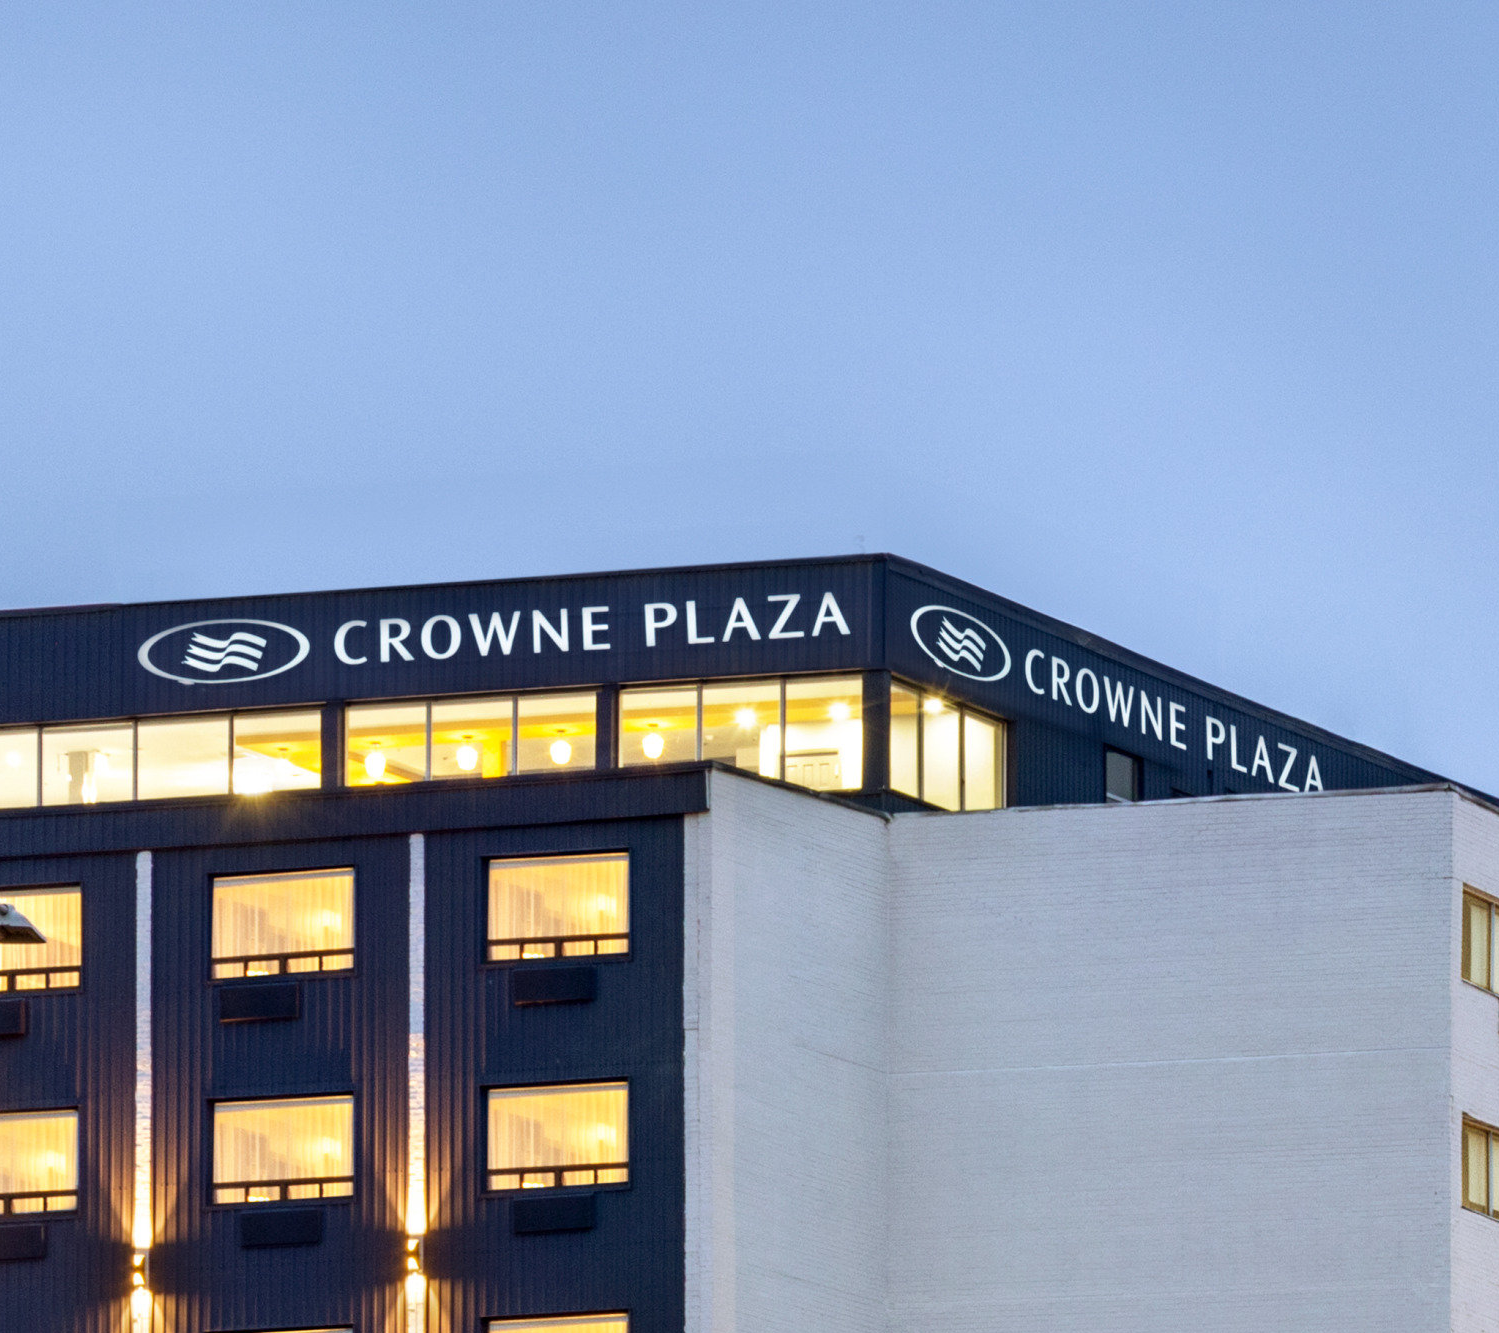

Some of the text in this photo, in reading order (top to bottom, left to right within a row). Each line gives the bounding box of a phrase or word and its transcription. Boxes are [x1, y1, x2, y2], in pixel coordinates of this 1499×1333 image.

[333, 591, 851, 665] CROWNE PLAZA
[1024, 648, 1325, 793] CROWNE PLAZA
